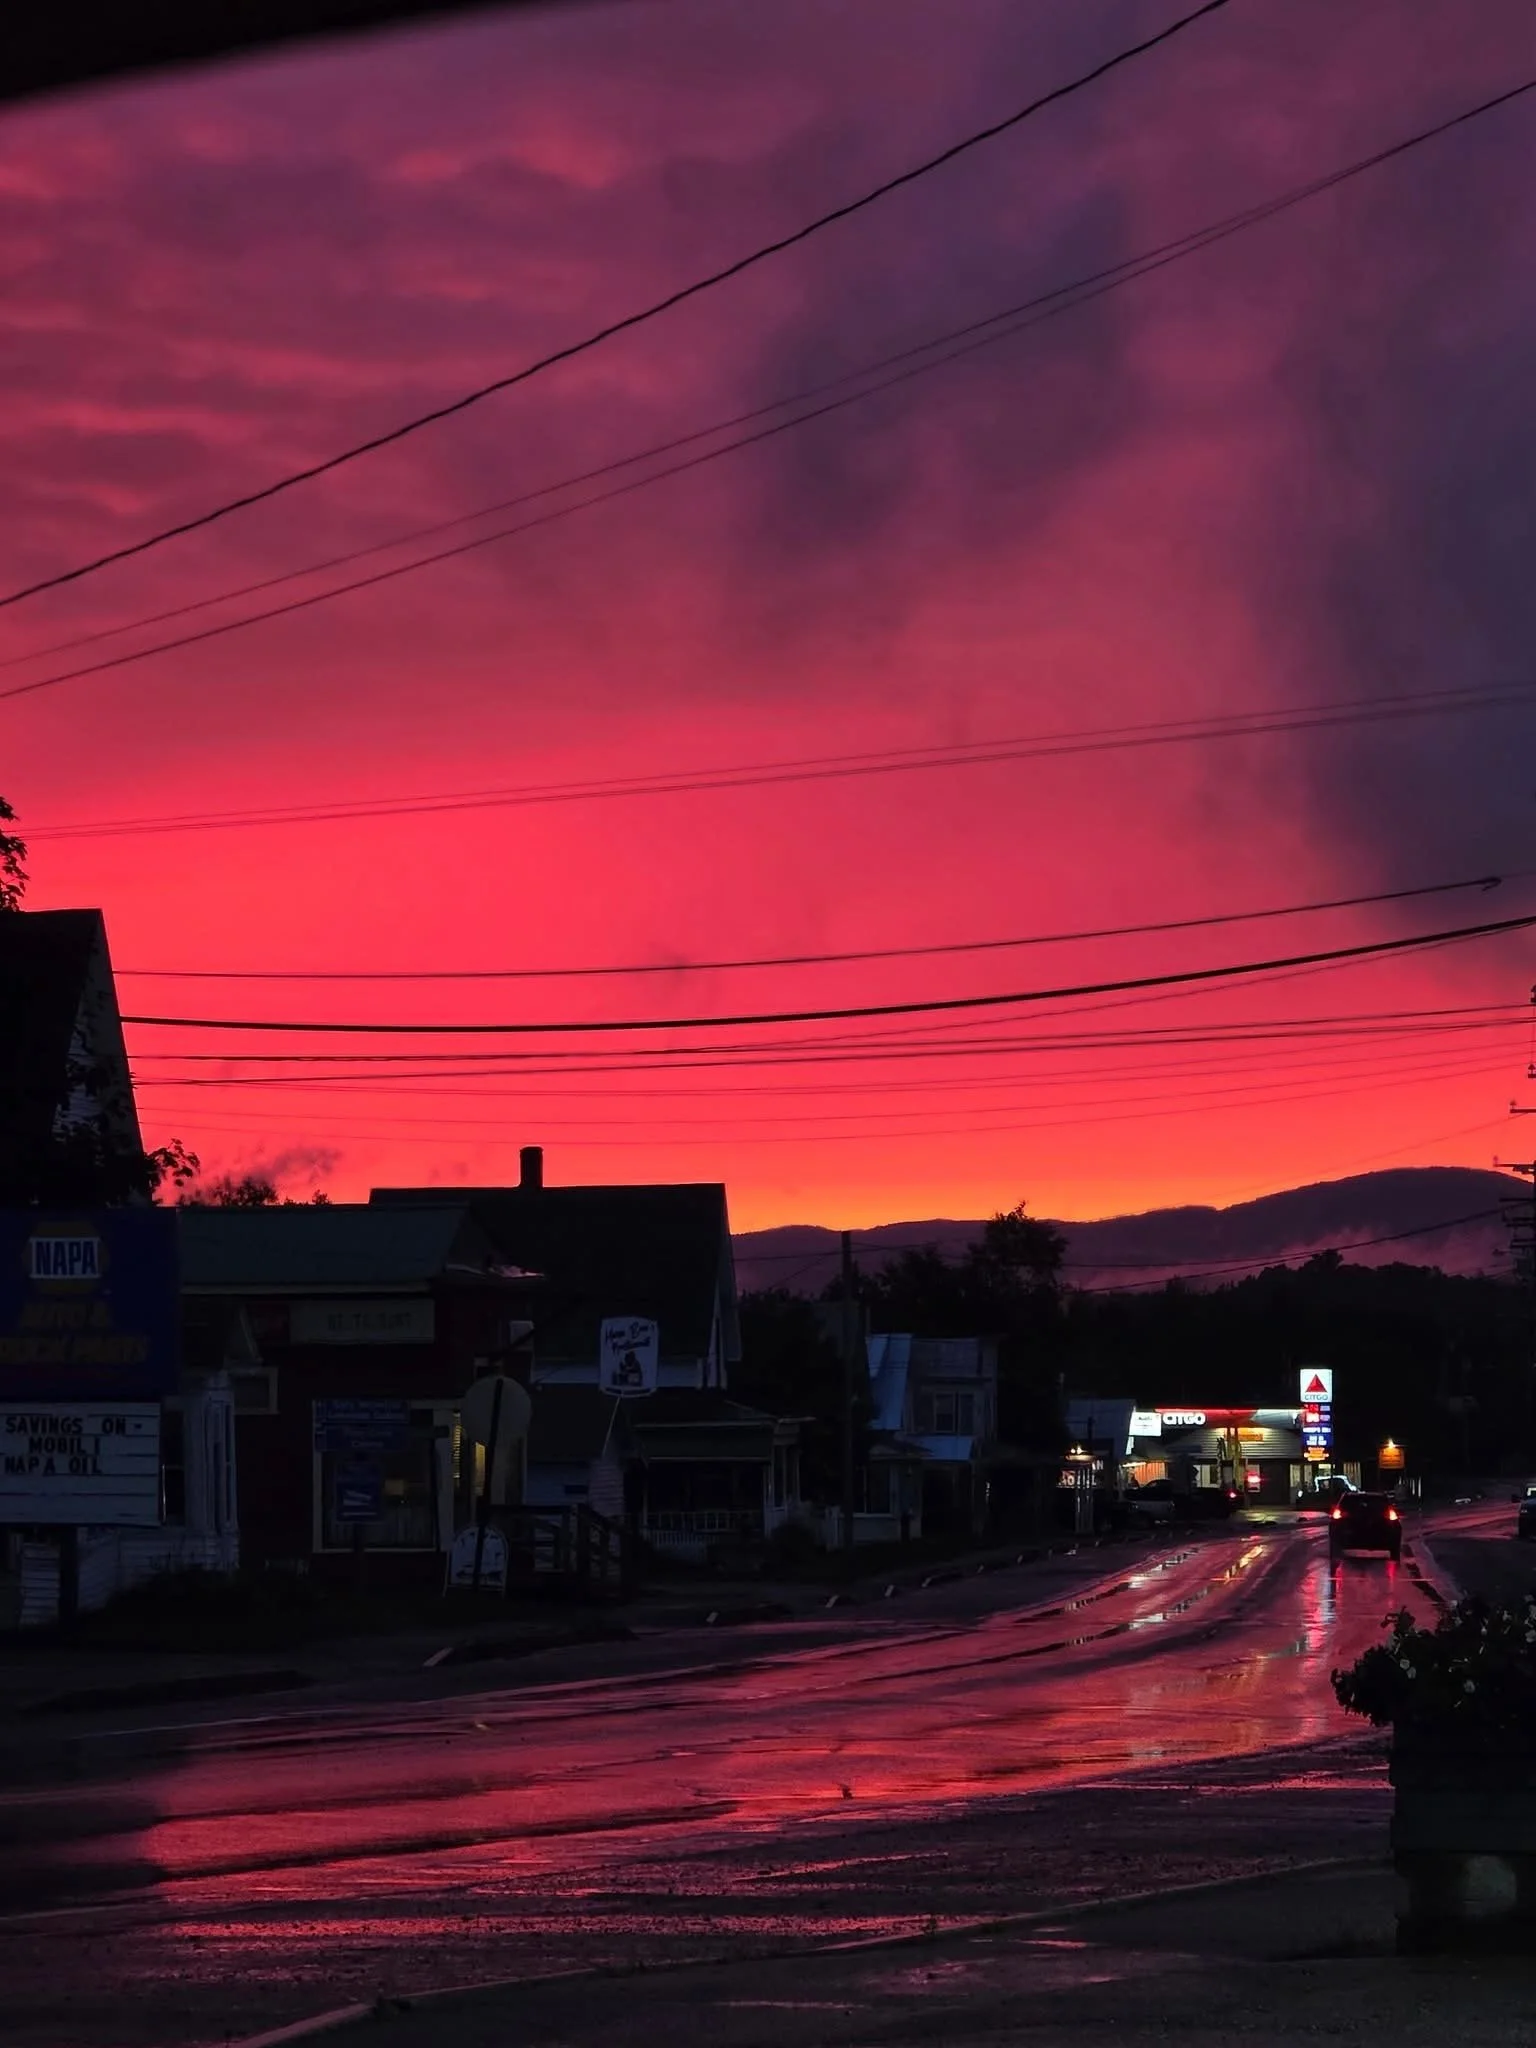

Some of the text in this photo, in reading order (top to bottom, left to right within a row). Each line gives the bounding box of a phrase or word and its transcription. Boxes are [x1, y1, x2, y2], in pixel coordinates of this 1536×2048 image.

[36, 1241, 97, 1275] NAPA
[6, 1416, 83, 1434] SAVINGS
[102, 1418, 126, 1434] ON
[1162, 1412, 1206, 1425] CITGO
[29, 1437, 86, 1454] MOBIL
[5, 1456, 102, 1475] NAPA OIL
